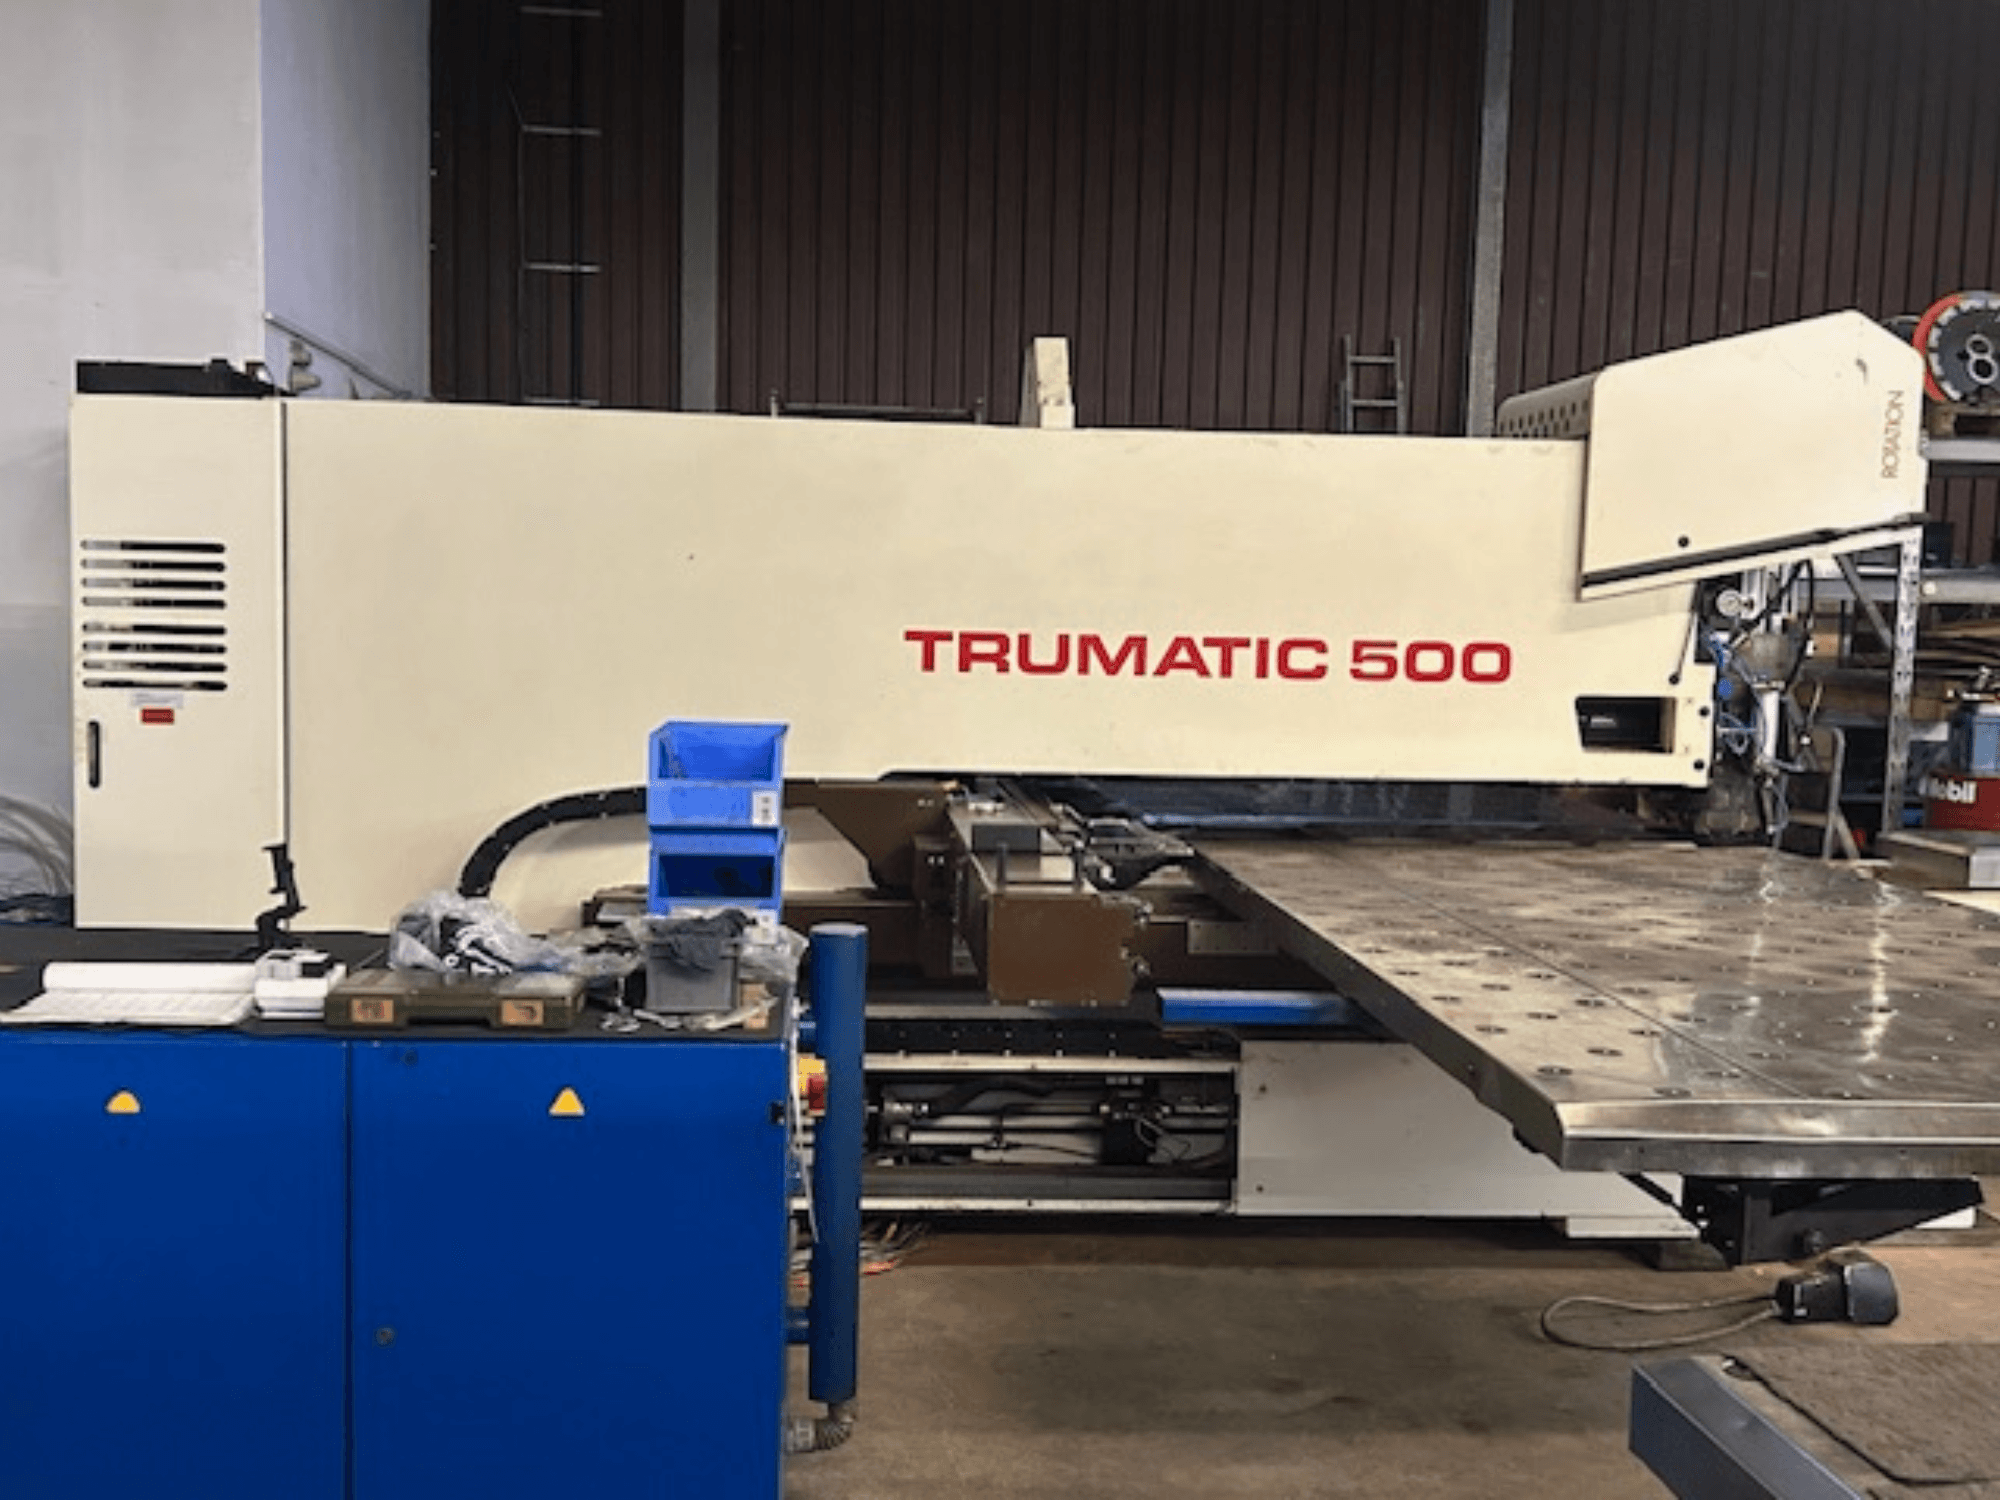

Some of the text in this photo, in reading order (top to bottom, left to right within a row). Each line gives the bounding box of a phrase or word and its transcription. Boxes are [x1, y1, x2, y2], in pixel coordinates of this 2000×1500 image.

[1881, 390, 1904, 478] ROTATION
[903, 629, 1512, 684] TRUMATIC 500
